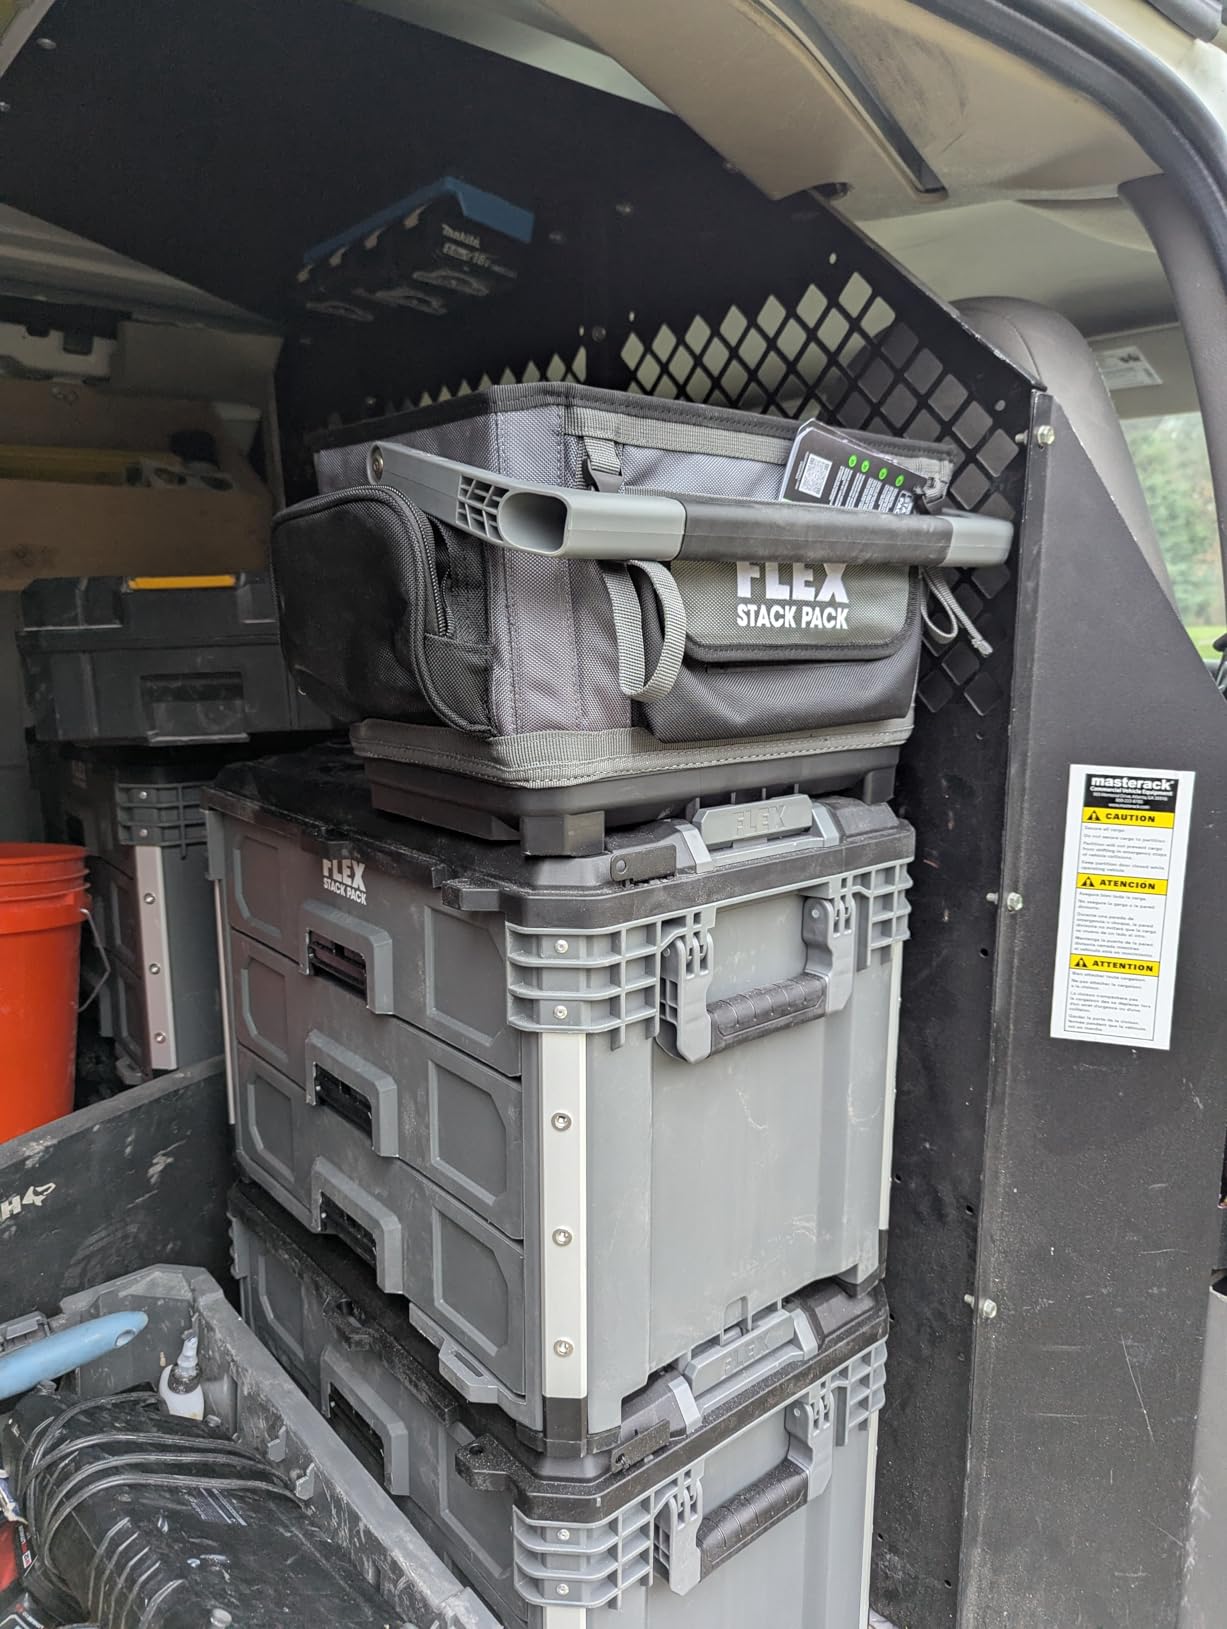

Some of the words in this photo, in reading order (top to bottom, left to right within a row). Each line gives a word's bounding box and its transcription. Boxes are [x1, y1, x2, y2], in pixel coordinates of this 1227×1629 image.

[736, 561, 849, 604] FLEX
[736, 603, 797, 628] STACK
[801, 605, 849, 630] PACK
[1090, 777, 1171, 790] masterack
[1105, 813, 1156, 823] CAUTION
[322, 858, 367, 892] FLEX
[323, 877, 346, 897] STACK
[346, 886, 368, 906] PACK
[1093, 960, 1153, 972] ATTENTION
